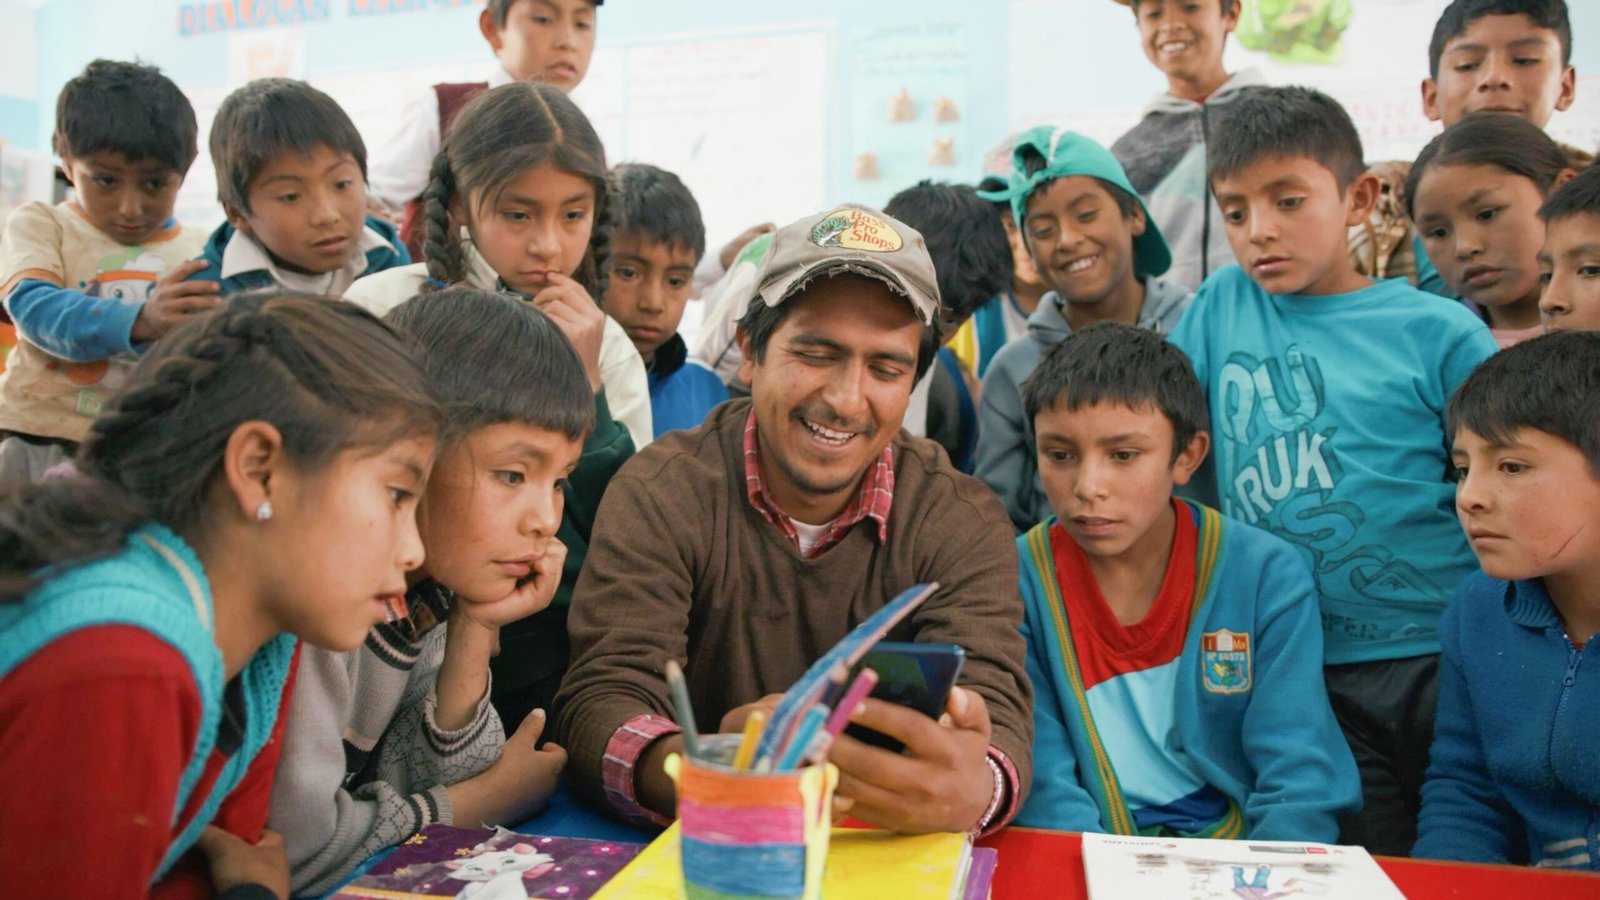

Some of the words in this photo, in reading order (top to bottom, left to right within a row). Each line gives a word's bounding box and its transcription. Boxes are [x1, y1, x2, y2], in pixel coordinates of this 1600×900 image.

[851, 208, 886, 229] Bass
[852, 220, 878, 236] Pro
[850, 230, 895, 250] Shops
